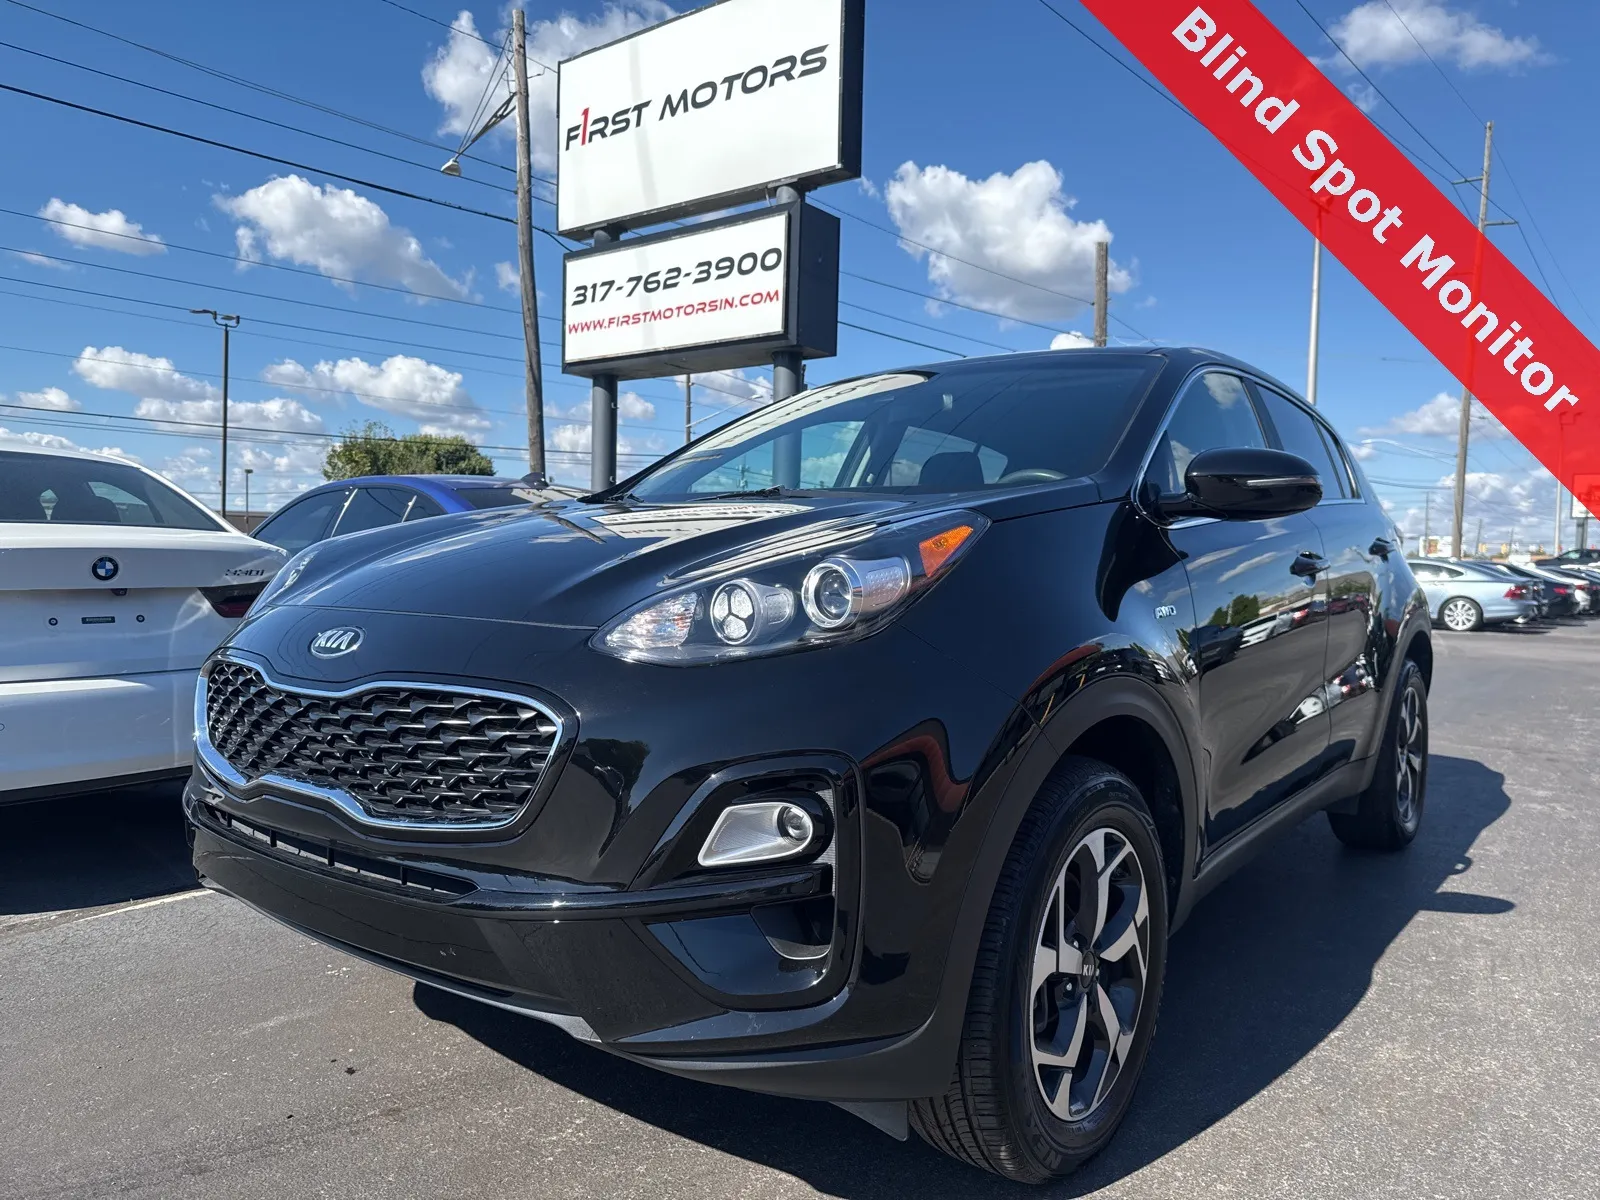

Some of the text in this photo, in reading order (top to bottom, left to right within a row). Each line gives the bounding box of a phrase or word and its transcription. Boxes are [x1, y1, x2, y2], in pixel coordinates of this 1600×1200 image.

[659, 44, 829, 121] MOTORS
[571, 247, 783, 307] 317-762-3900
[568, 289, 780, 335] WWW.FIRSTMOTORSIN.COM
[314, 630, 355, 650] KIA
